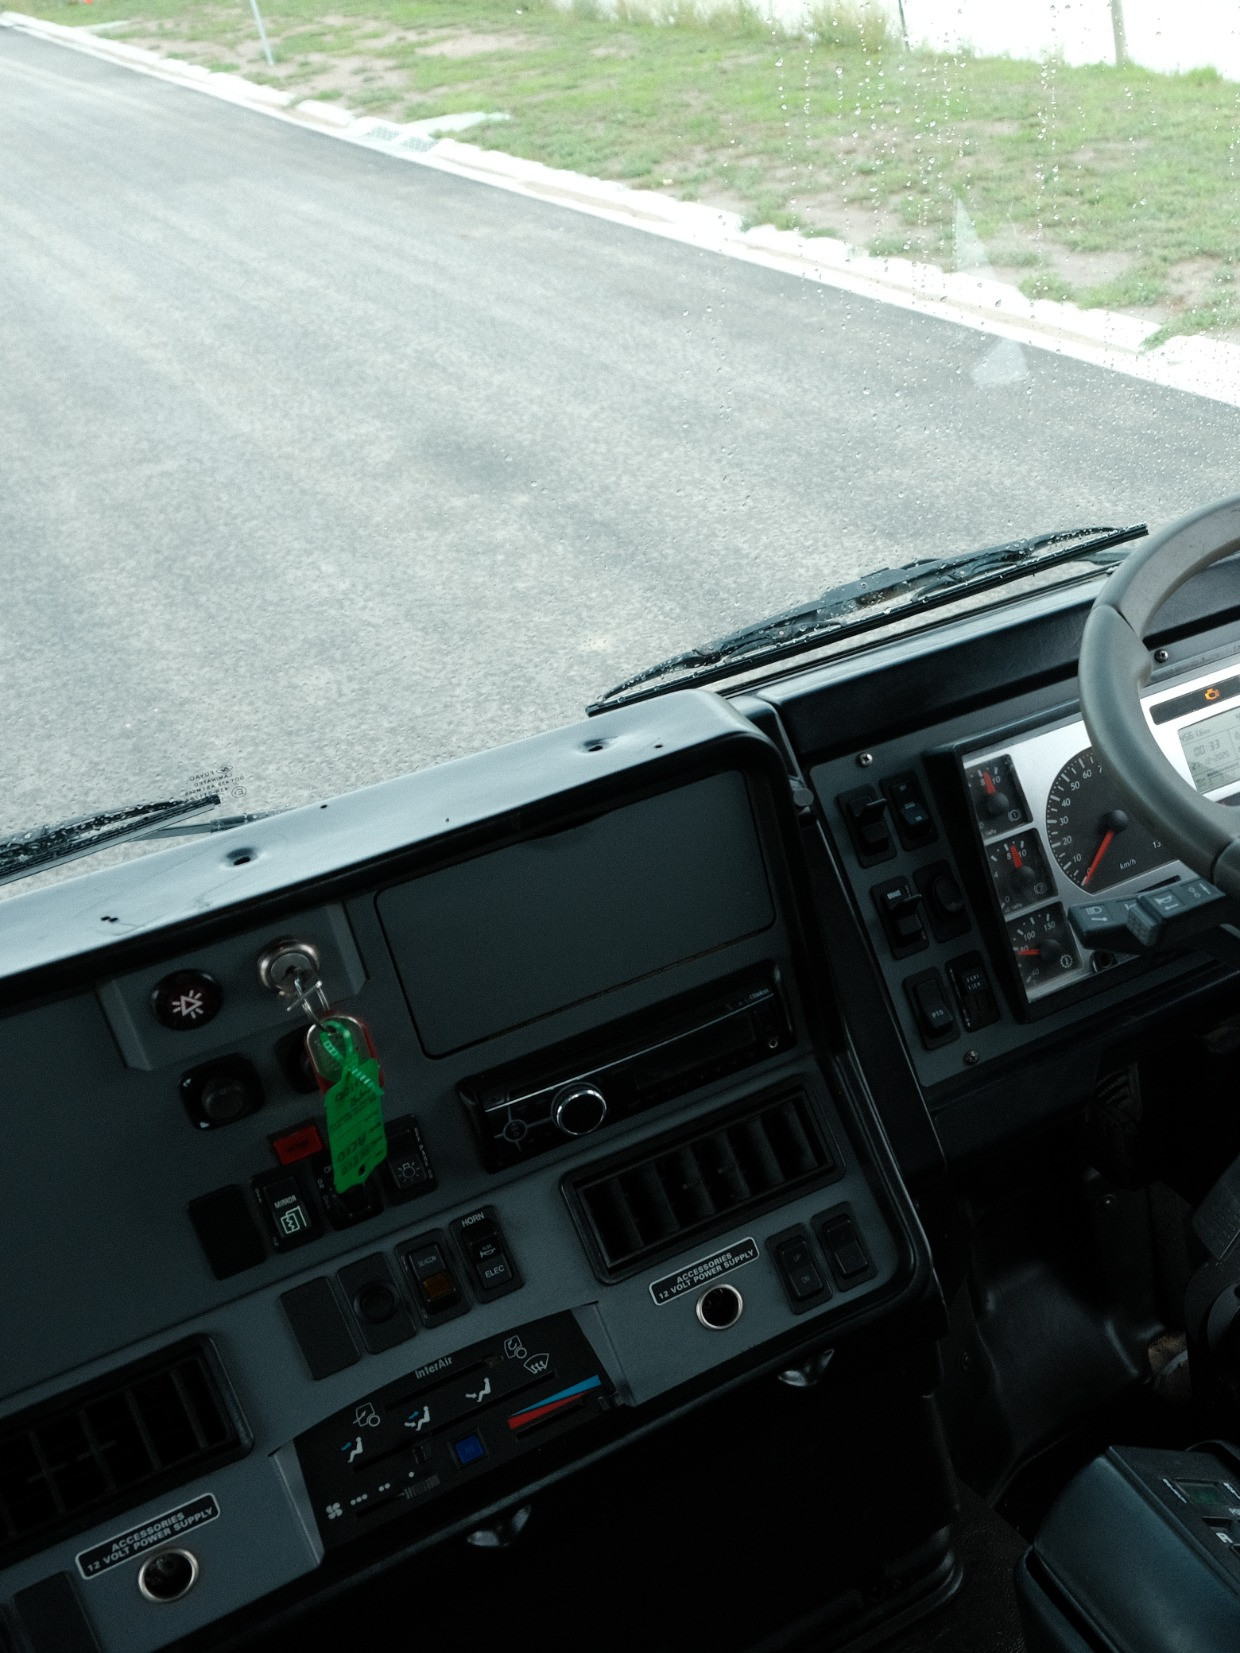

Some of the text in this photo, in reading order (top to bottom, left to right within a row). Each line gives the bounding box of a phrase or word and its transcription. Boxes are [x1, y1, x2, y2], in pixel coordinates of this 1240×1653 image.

[1082, 769, 1092, 779] 60
[1070, 780, 1080, 791] 50
[1061, 797, 1071, 808] 40
[1059, 815, 1069, 826] 30
[1062, 835, 1072, 846] 20
[1072, 853, 1082, 863] 10
[1119, 858, 1137, 870] km/h
[1043, 920, 1056, 932] 150
[1023, 930, 1036, 942] 100
[460, 1210, 485, 1228] HORN
[484, 1264, 506, 1279] ELEC
[676, 1252, 733, 1284] ACCESSORIES
[658, 1248, 756, 1301] 12 VOLT POWER SUPPLY
[415, 1355, 453, 1381] InterAir
[110, 1511, 186, 1552] ACCESSORIES
[87, 1506, 214, 1573] 12 VOLT POWER SUPPLY
[1215, 1532, 1234, 1544] R
